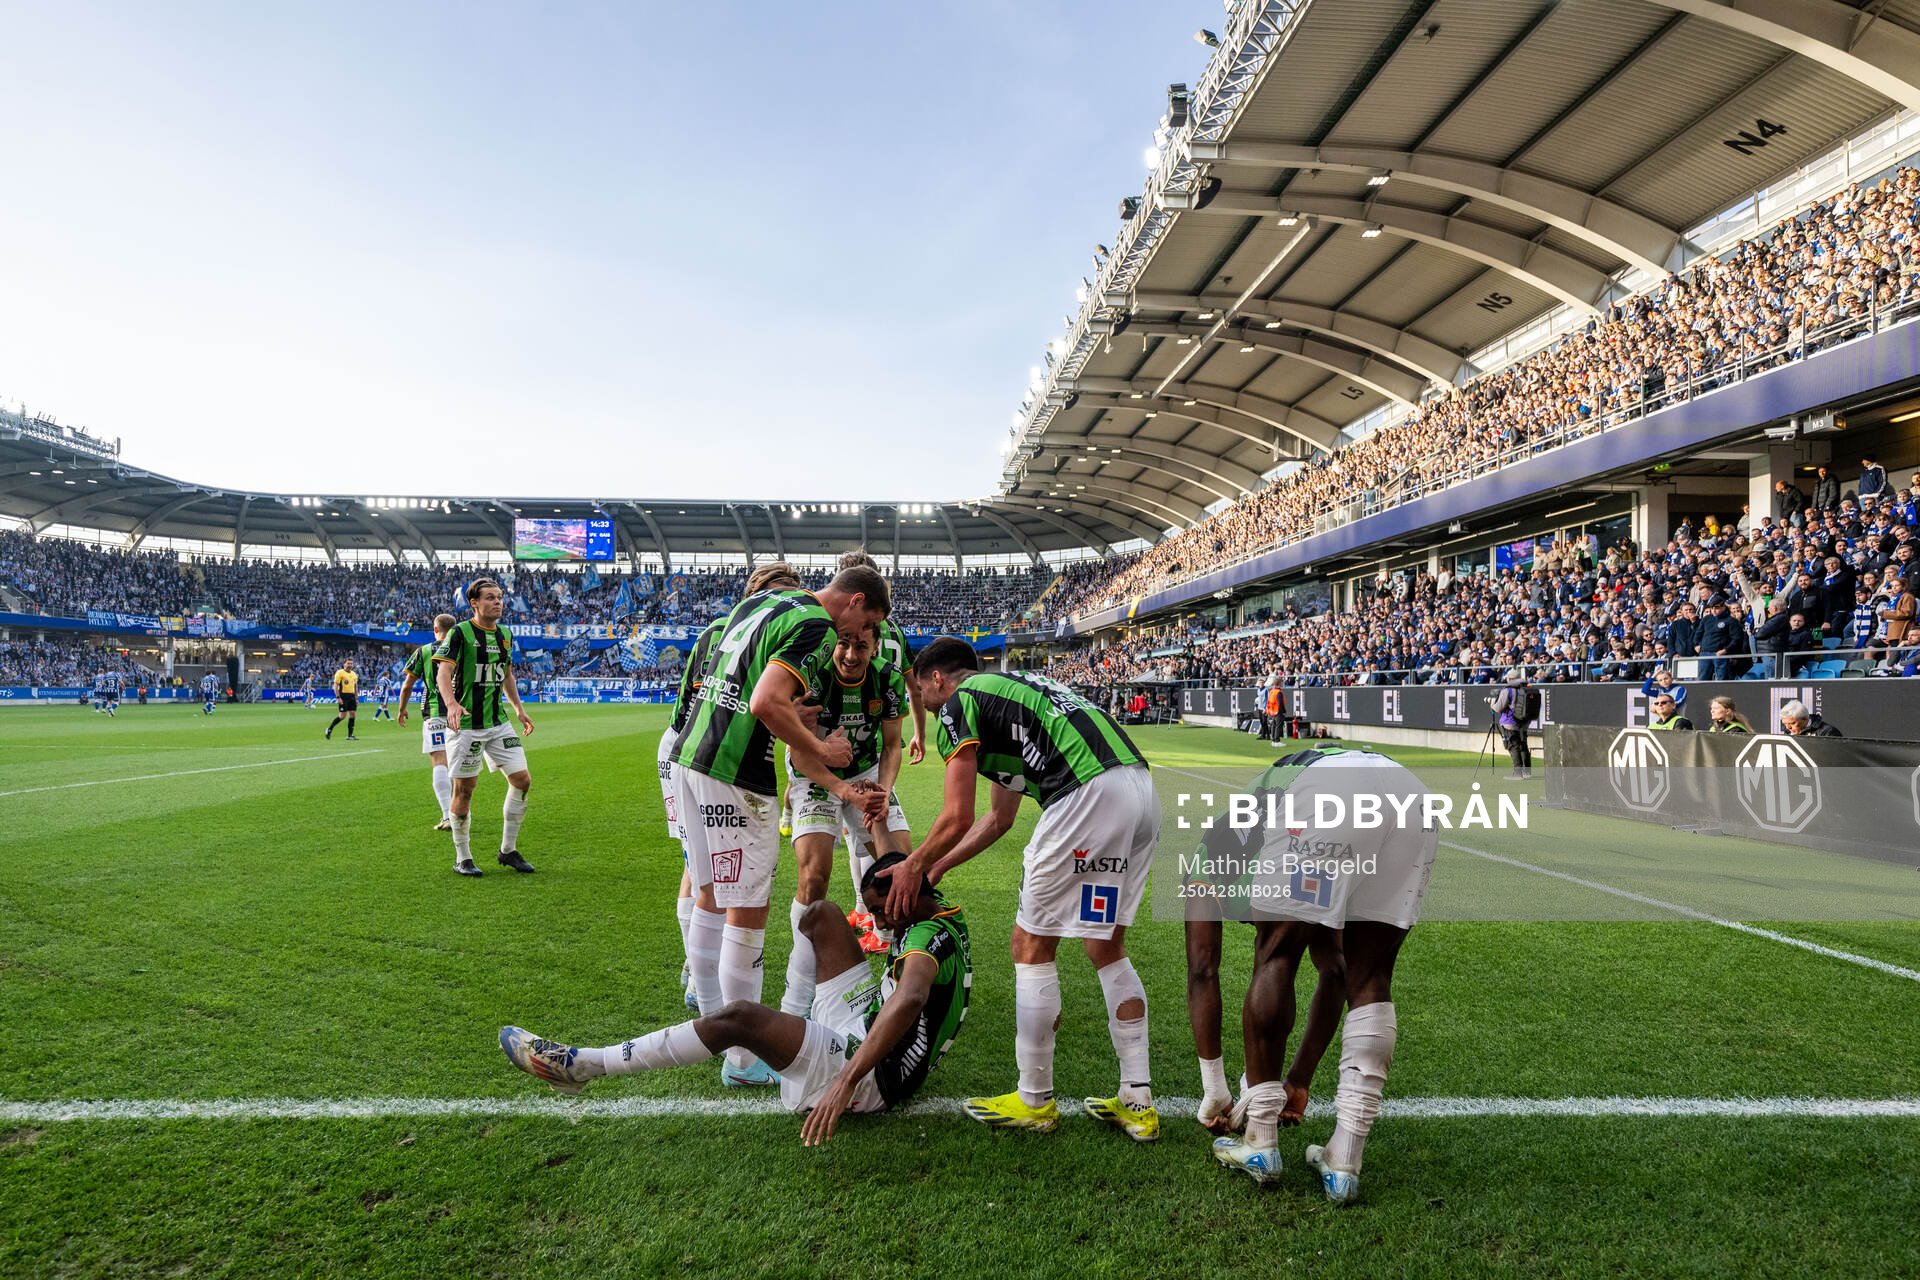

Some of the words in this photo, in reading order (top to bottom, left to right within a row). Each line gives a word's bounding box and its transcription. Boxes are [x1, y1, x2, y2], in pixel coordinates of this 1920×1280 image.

[1723, 118, 1787, 156] N4
[1476, 292, 1513, 314] N5
[1340, 386, 1365, 400] L5
[1812, 420, 1824, 429] M3
[719, 608, 775, 675] 4
[1184, 691, 1193, 711] EL
[1205, 690, 1215, 712] EL
[1293, 690, 1307, 717] EL
[1333, 690, 1350, 719] EL
[1382, 689, 1403, 722] EL
[1444, 689, 1469, 725] EL
[1613, 735, 1664, 803] MG
[1743, 743, 1812, 824] MG
[1287, 835, 1354, 859] RASTA
[1073, 857, 1128, 874] RASTA
